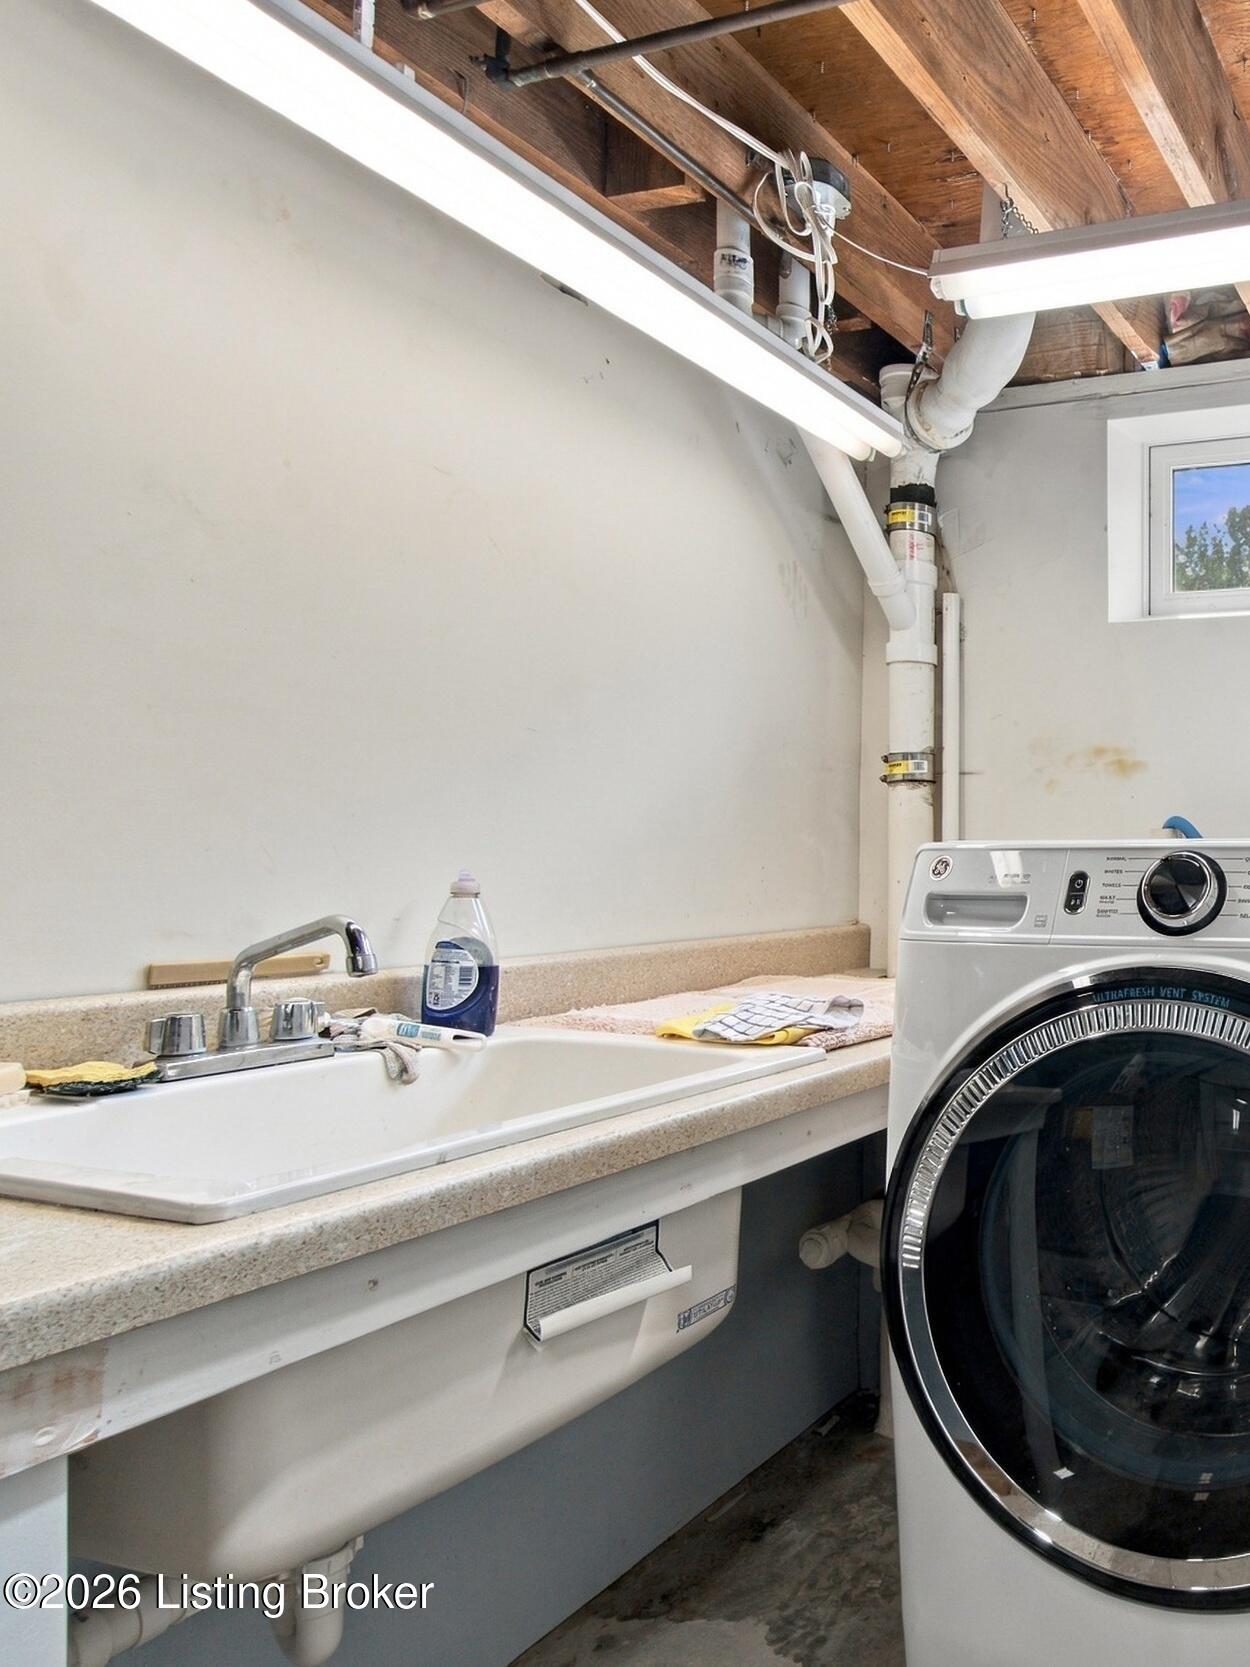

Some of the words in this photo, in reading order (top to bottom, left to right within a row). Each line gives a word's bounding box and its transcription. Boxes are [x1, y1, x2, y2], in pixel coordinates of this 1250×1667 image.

[1093, 986, 1155, 1004] ULTRAFRESH
[1159, 986, 1187, 999] VENT
[1192, 989, 1231, 1009] SYSTEM
